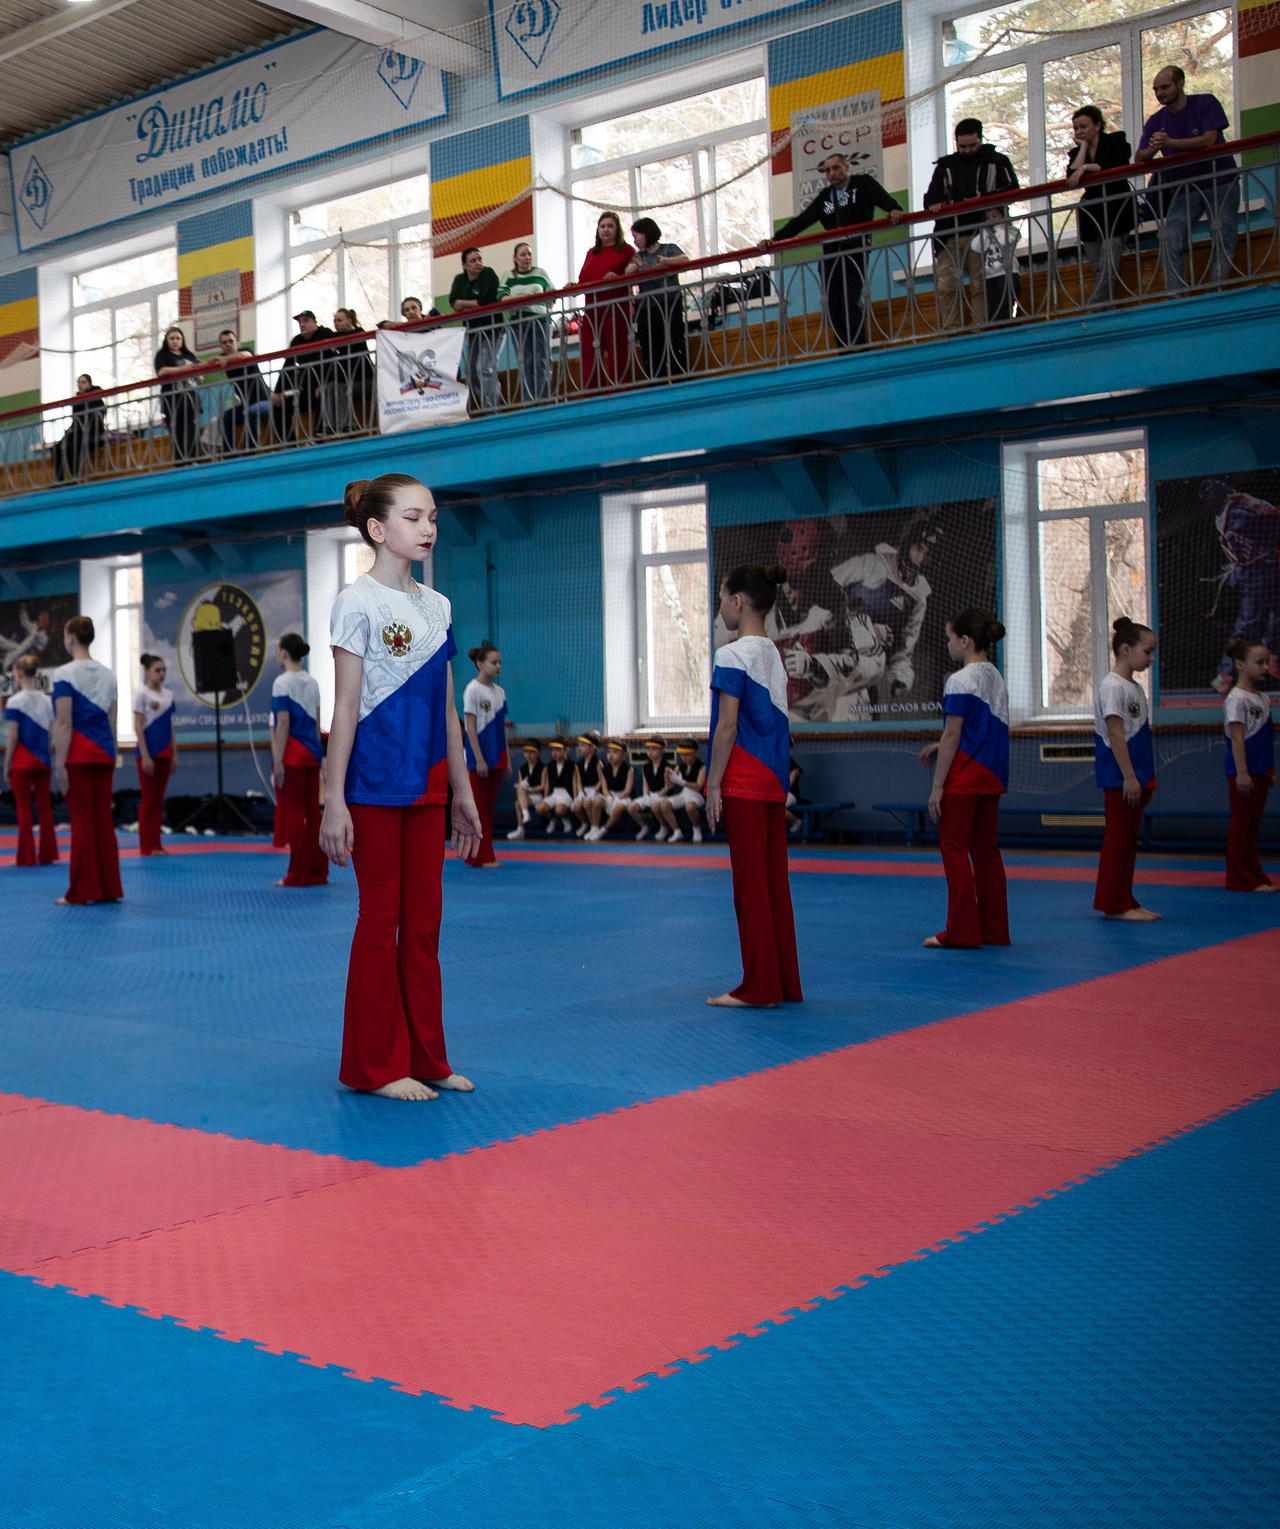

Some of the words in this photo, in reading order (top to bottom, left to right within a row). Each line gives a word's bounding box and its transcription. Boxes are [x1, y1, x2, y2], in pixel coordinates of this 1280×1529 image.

[641, 0, 708, 35] Лидер
[802, 124, 871, 155] СССР
[127, 162, 196, 206] Традиции
[200, 125, 289, 179] побеждать!
[890, 702, 919, 713] СЛОВ
